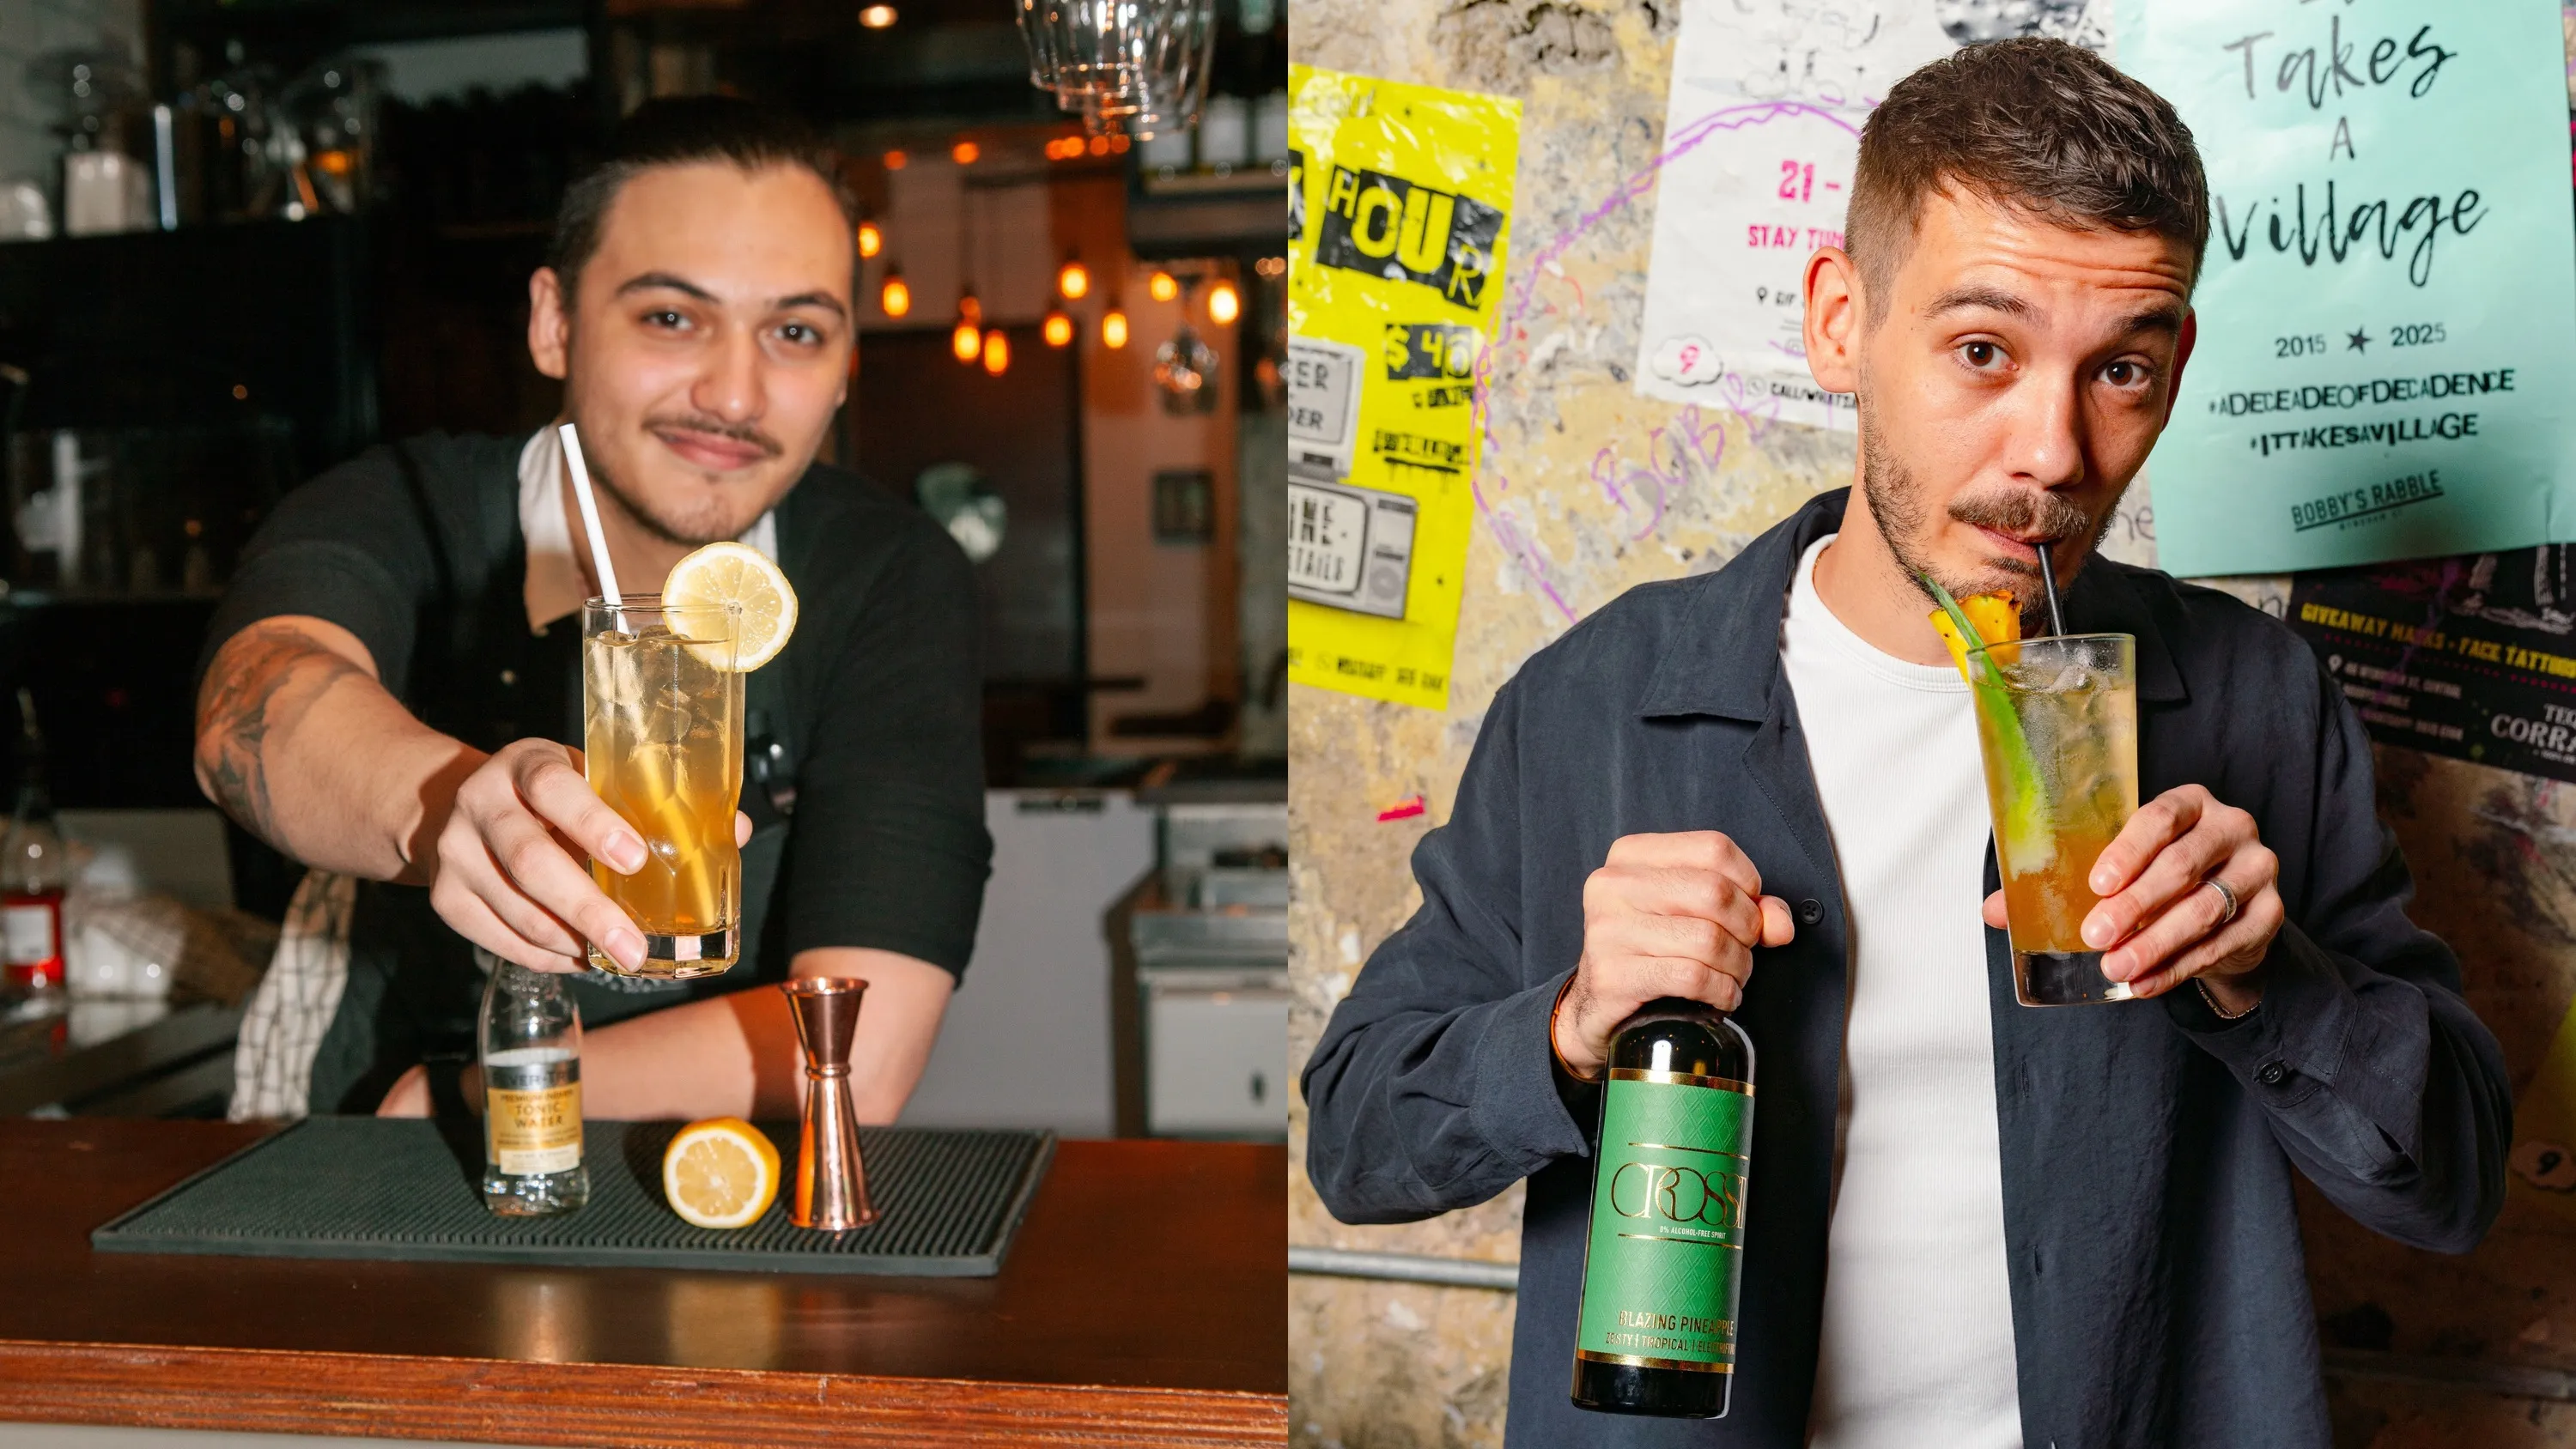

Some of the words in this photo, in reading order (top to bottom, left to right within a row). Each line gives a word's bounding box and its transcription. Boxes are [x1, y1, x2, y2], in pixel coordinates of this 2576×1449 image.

[2222, 15, 2458, 110] Takes
[2330, 116, 2355, 161] A
[1779, 160, 1814, 203] 21
[1325, 167, 1486, 307] HOUR
[1748, 224, 1800, 248] STAY
[2216, 180, 2489, 288] Village
[2275, 334, 2327, 359] 2015
[2391, 322, 2446, 347] 2025
[2290, 488, 2368, 526] BOBBY'S
[2371, 469, 2443, 506] RABBLE
[2300, 602, 2389, 638] GIVEAWAY
[2458, 637, 2502, 664] FACE
[515, 1115, 563, 1129] WATER
[516, 1100, 567, 1115] TONIC
[1671, 1226, 1710, 1239] ALCOHOL-FREE
[1710, 1231, 1727, 1240] SPIRIT
[1606, 1331, 1632, 1347] ZESTY
[1642, 1335, 1688, 1351] TROPICAL
[1619, 1310, 1676, 1331] BLAZING
[1680, 1316, 1735, 1337] PINEAPPLE
